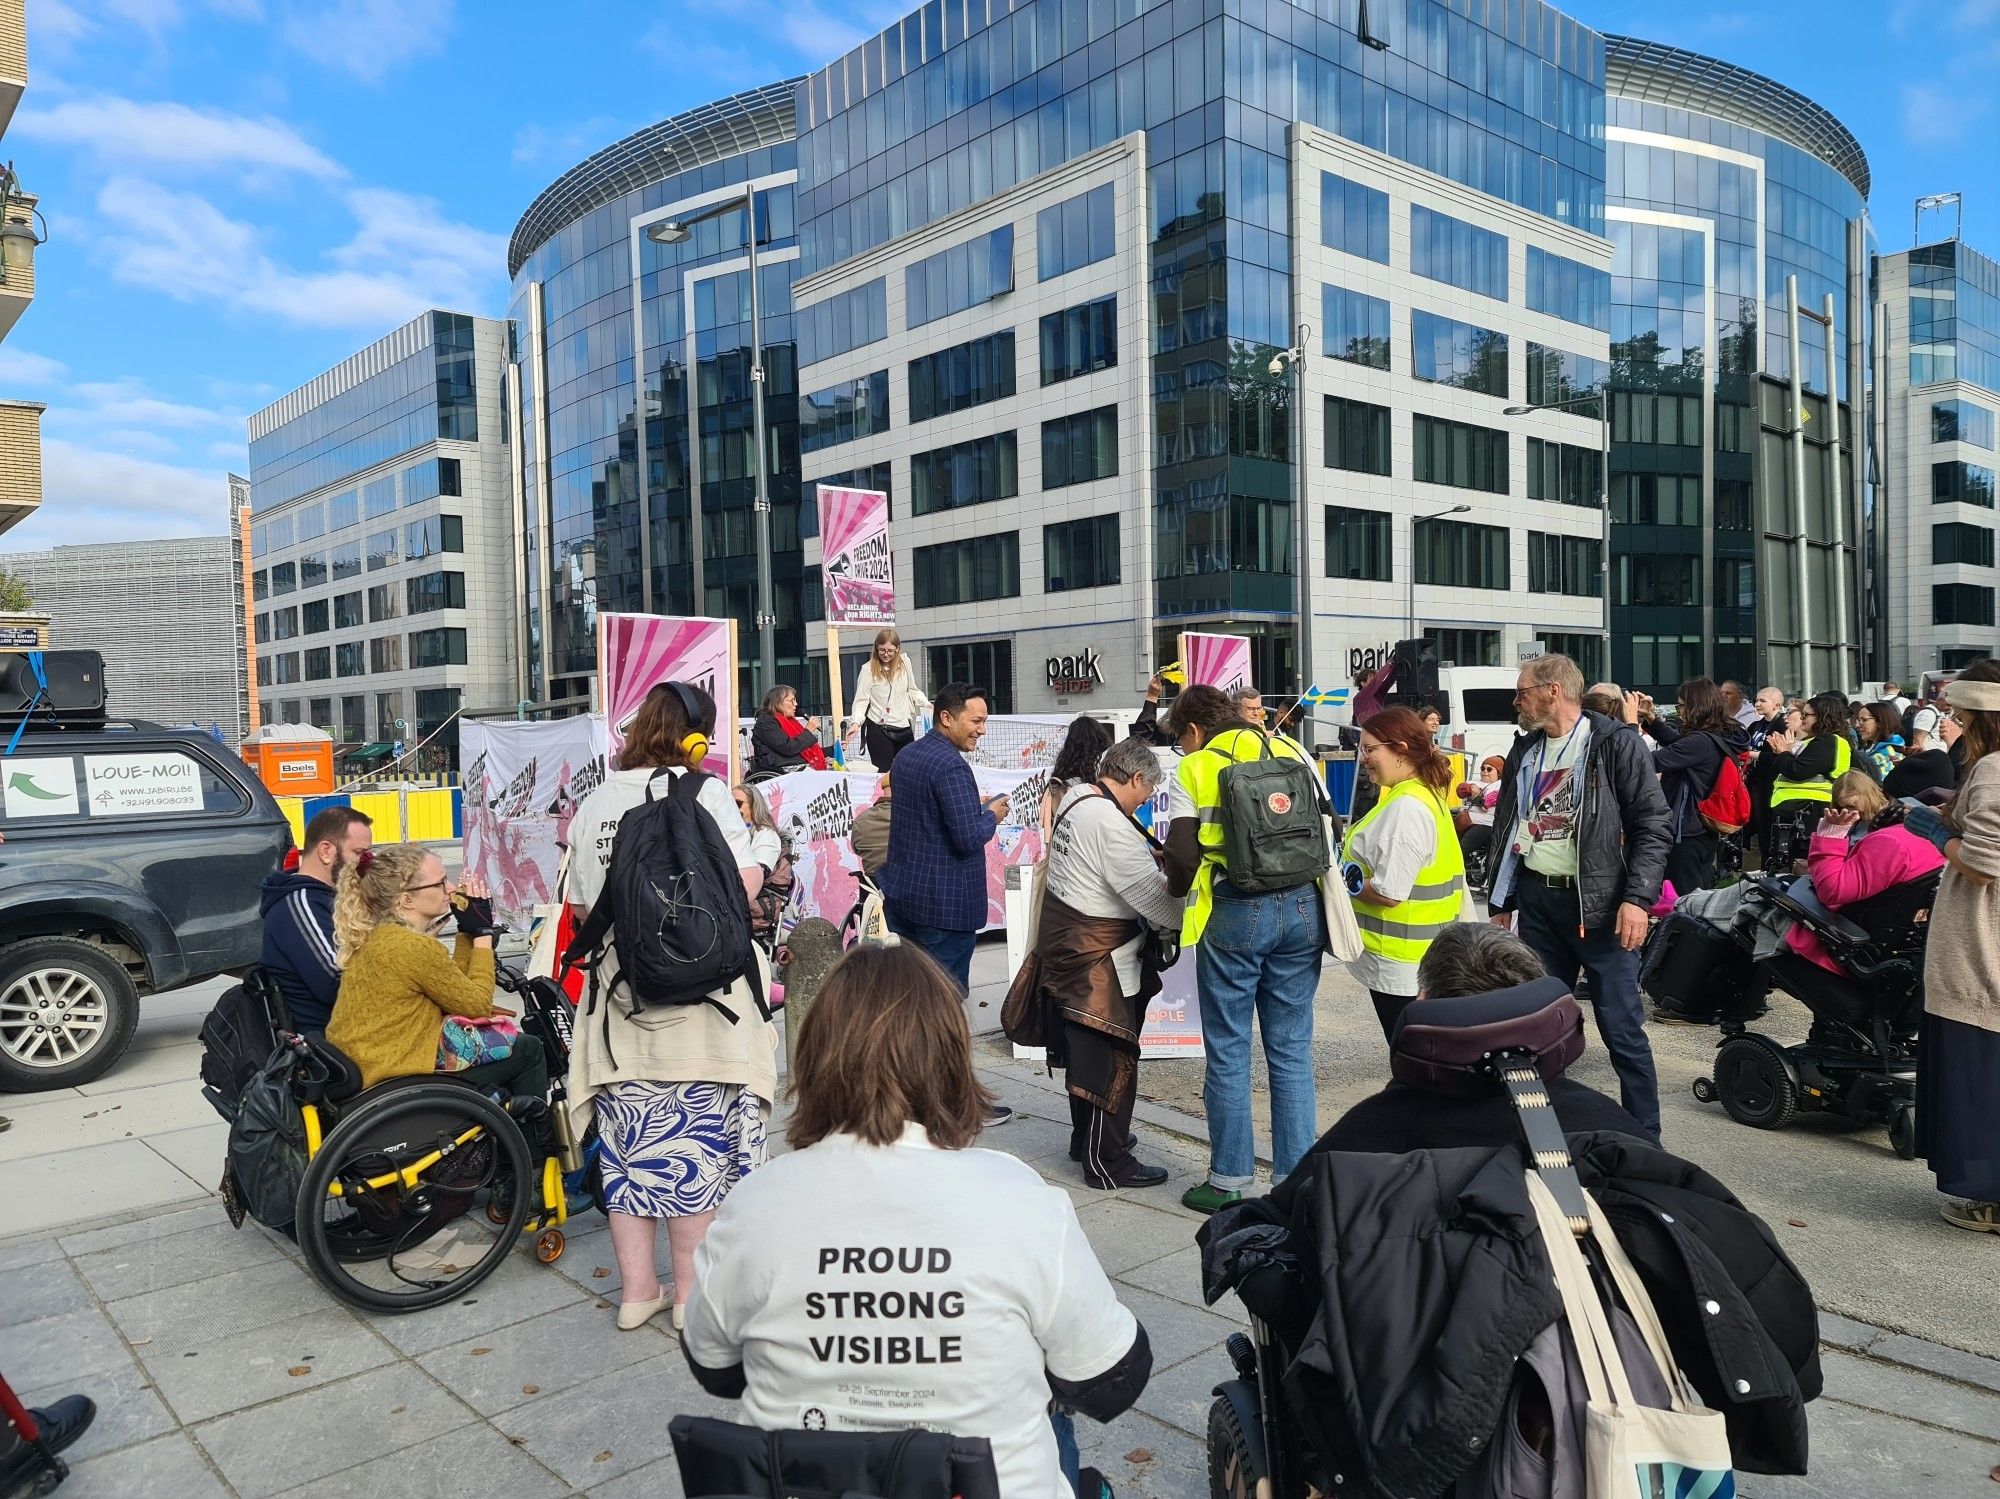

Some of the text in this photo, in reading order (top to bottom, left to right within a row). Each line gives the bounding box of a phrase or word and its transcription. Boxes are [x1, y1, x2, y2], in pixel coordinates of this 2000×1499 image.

[854, 533, 888, 562] FREEDOM
[855, 558, 889, 580] DRIVE 2024
[847, 603, 879, 611] RECLAIMING
[847, 611, 859, 619] OUR
[859, 610, 883, 619] RIGHTS
[1046, 648, 1103, 686] park
[92, 764, 191, 780] LOUE-MOI!
[282, 764, 315, 772] Boels
[120, 786, 193, 796] WWW.JABIRU.BE
[807, 777, 852, 822] FREEDOM
[1011, 769, 1047, 808] FREEDOM
[1029, 799, 1040, 823] 20
[811, 805, 854, 842] DRIVE 2024
[1139, 1037, 1179, 1045] choeurs.be
[818, 1247, 951, 1274] PROUD
[806, 1291, 965, 1319] STRONG
[808, 1336, 962, 1364] VISIBLE
[837, 1383, 936, 1399] 23-25 September 2024
[888, 1399, 924, 1410] Belgium
[839, 1415, 857, 1425] The
